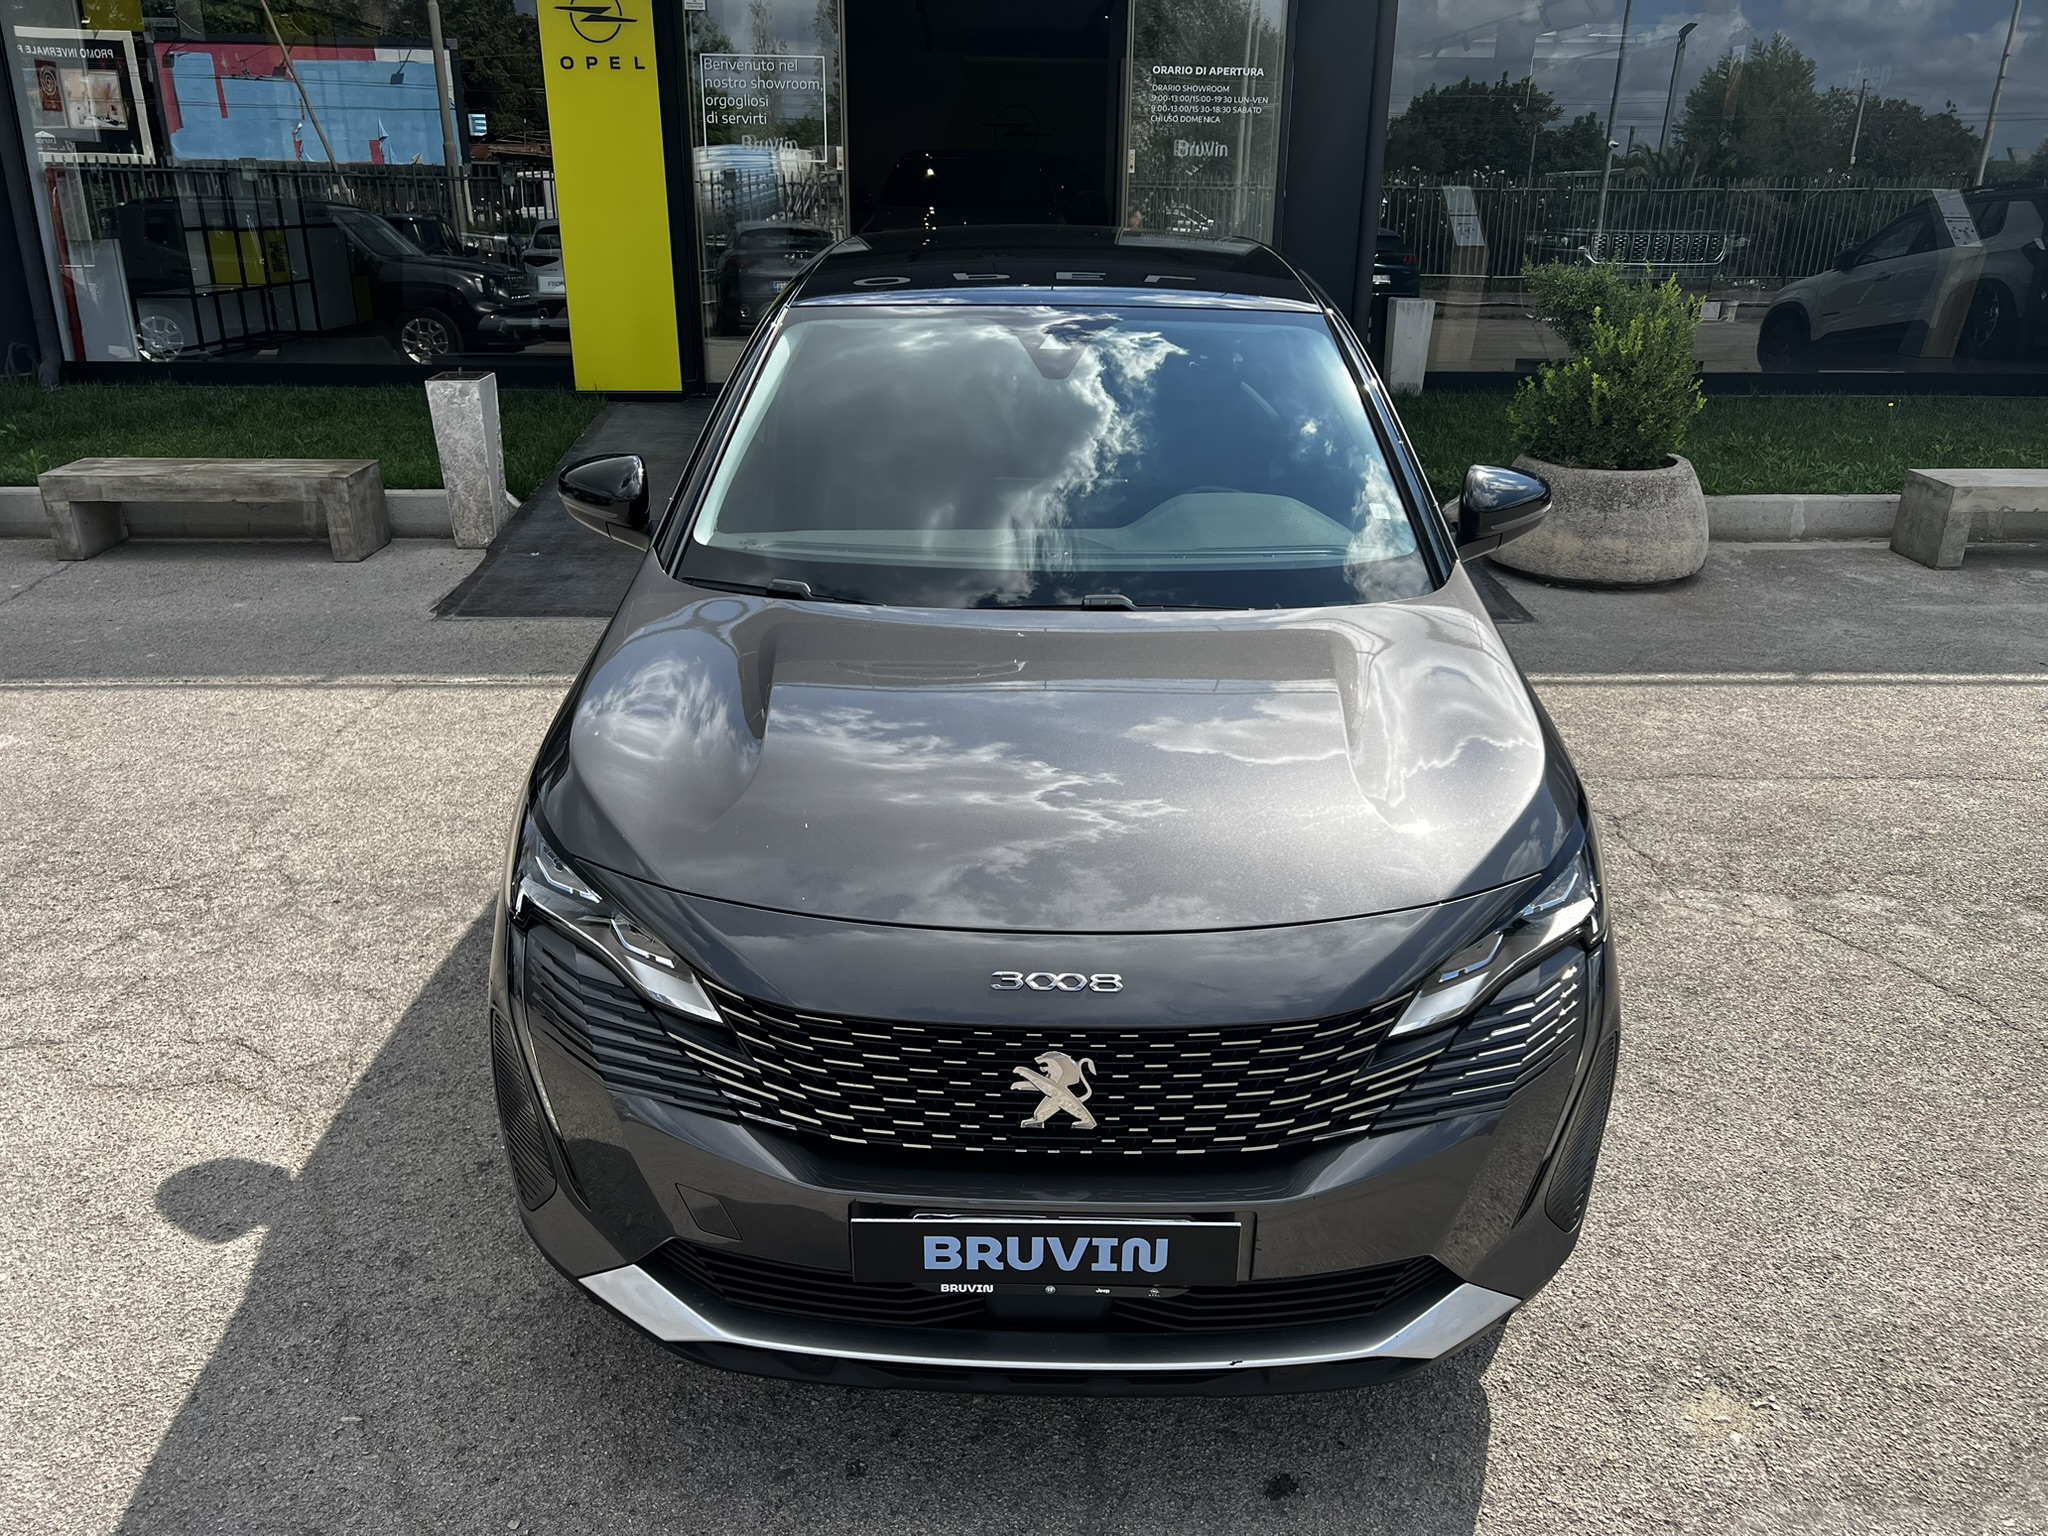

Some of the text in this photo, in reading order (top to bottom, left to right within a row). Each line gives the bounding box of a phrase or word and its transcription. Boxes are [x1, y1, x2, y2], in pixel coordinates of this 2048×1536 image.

[560, 55, 646, 70] OPEL
[703, 57, 798, 72] Benvenuto nel
[1152, 65, 1264, 77] ORARIO DI APERTURA
[704, 76, 824, 92] nostro showroom,
[1152, 84, 1229, 93] ORARIO SHOWROOM
[705, 94, 769, 110] orgogliosi
[1233, 96, 1269, 104] LUN-VEN
[1232, 106, 1262, 114] SABATO
[706, 112, 767, 125] di servirti
[1151, 115, 1179, 123] CHIUSO
[990, 970, 1124, 993] 3008
[923, 1235, 1169, 1273] BRUVIN
[940, 1283, 994, 1294] BRUVIN
[1095, 1287, 1111, 1295] Jeep
